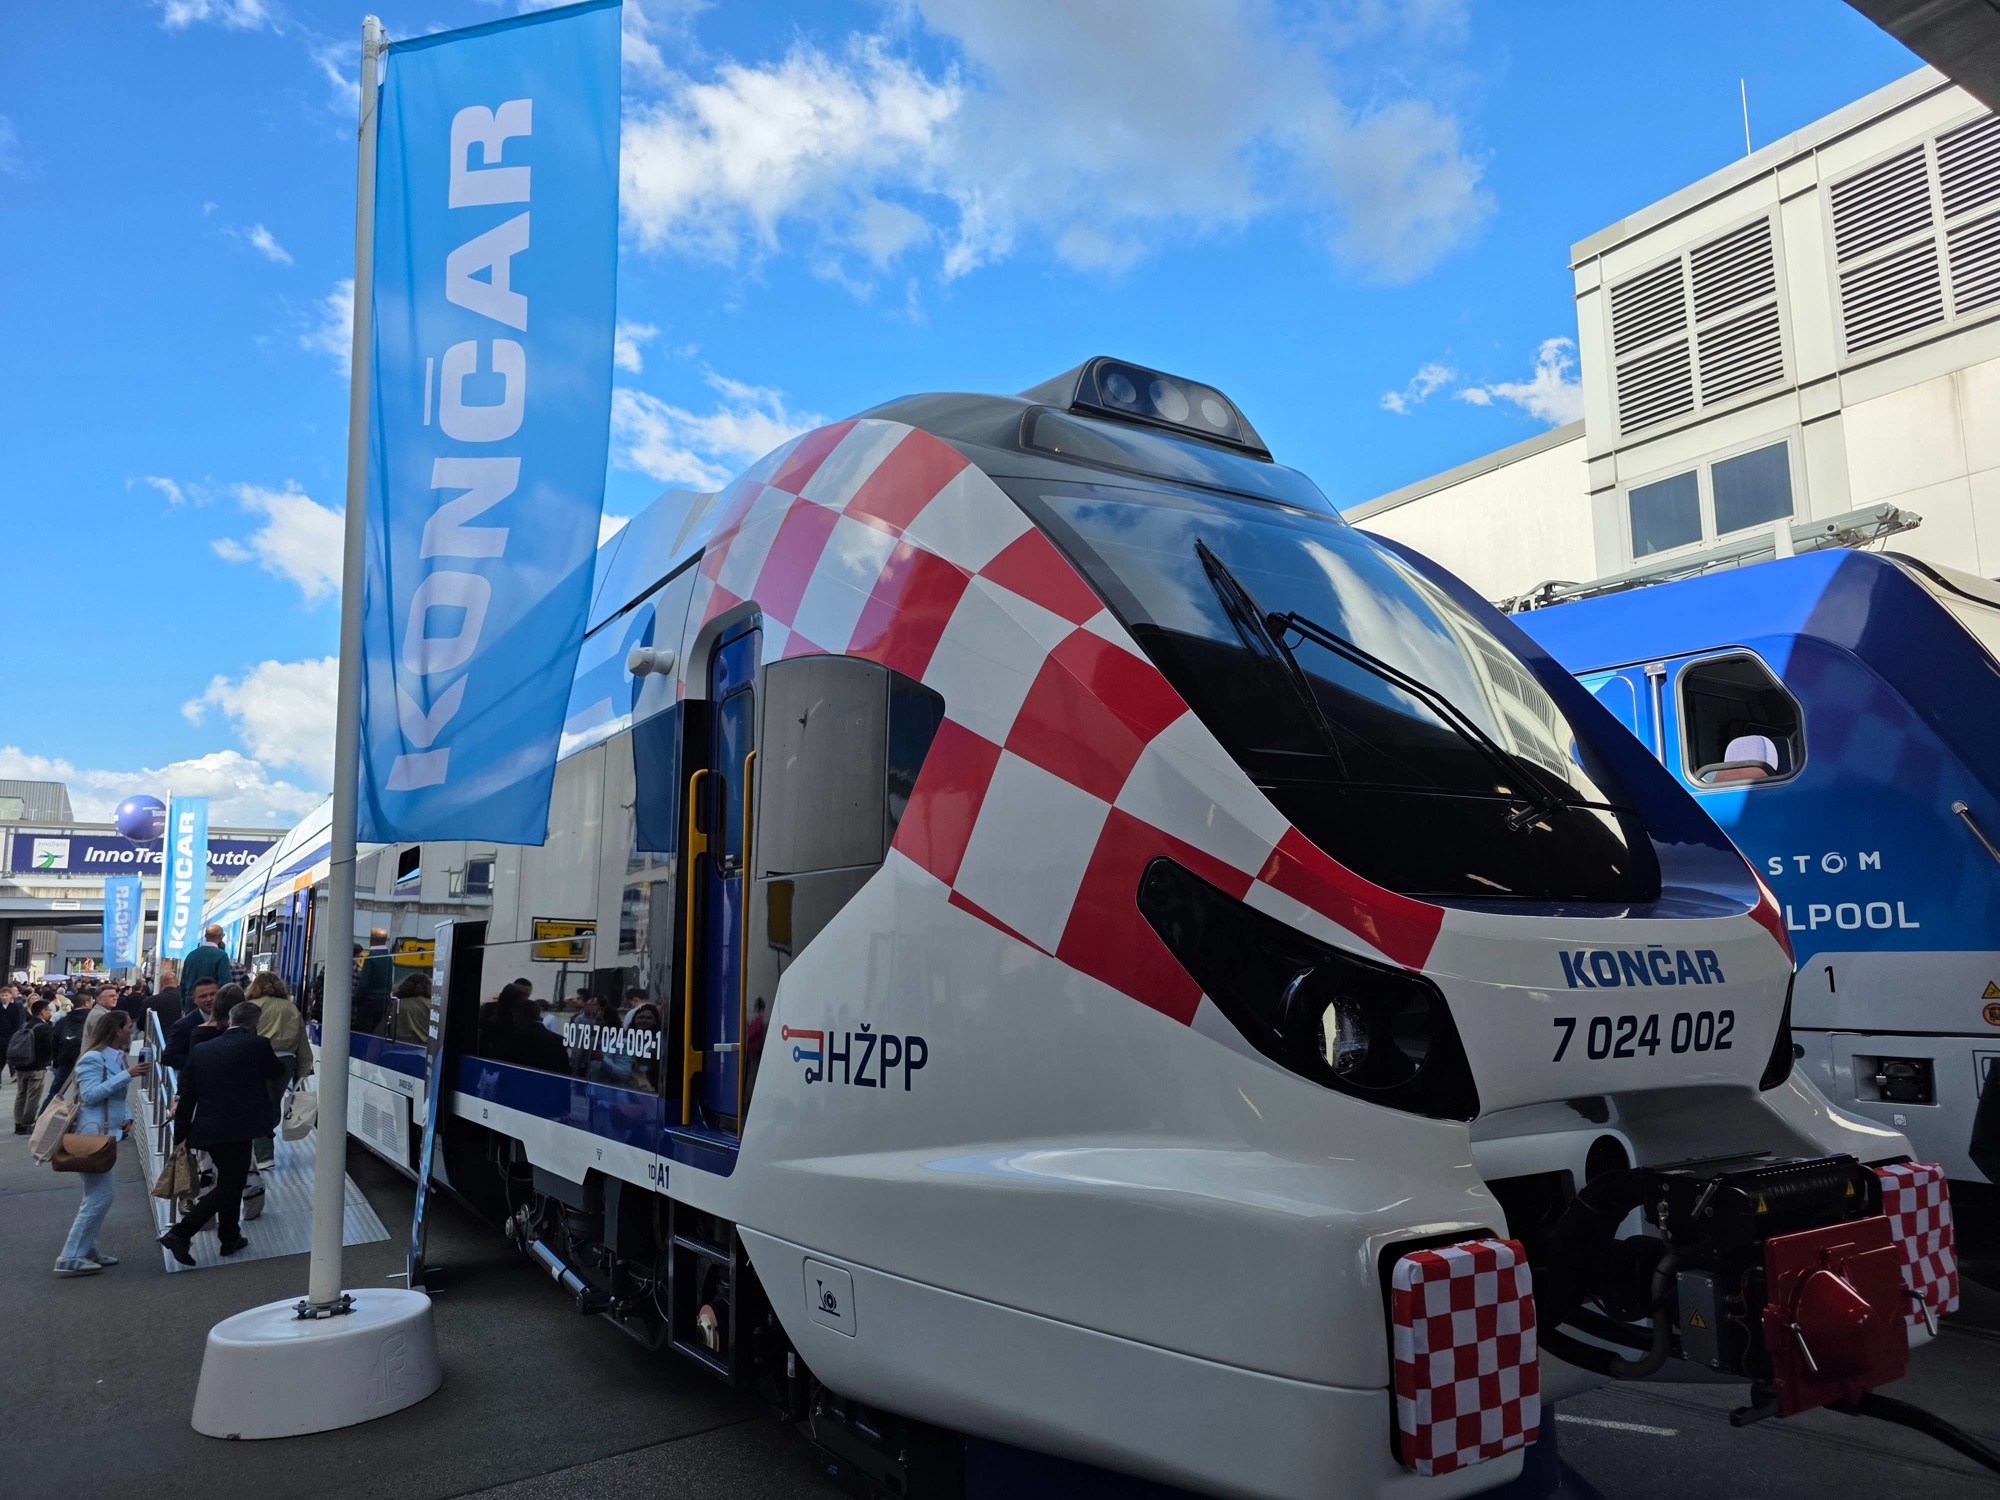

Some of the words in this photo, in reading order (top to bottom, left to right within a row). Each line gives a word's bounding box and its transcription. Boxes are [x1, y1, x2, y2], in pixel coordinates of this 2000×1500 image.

[84, 846, 164, 864] InnoTra
[206, 849, 259, 866] utdo
[1768, 851, 1881, 876] STOM
[1786, 901, 1920, 931] LPOOL
[1824, 966, 1835, 993] 1
[563, 1022, 576, 1048] 90
[578, 1023, 591, 1050] 78
[593, 1025, 601, 1051] 7
[601, 1026, 624, 1055] 024
[627, 1028, 662, 1060] 002-1
[1552, 1018, 1576, 1062] 7
[1587, 1014, 1661, 1060] 024
[1671, 1010, 1735, 1052] 002
[828, 1023, 929, 1092] HŽPP
[648, 1164, 656, 1180] 1D
[657, 1162, 670, 1190] A1
